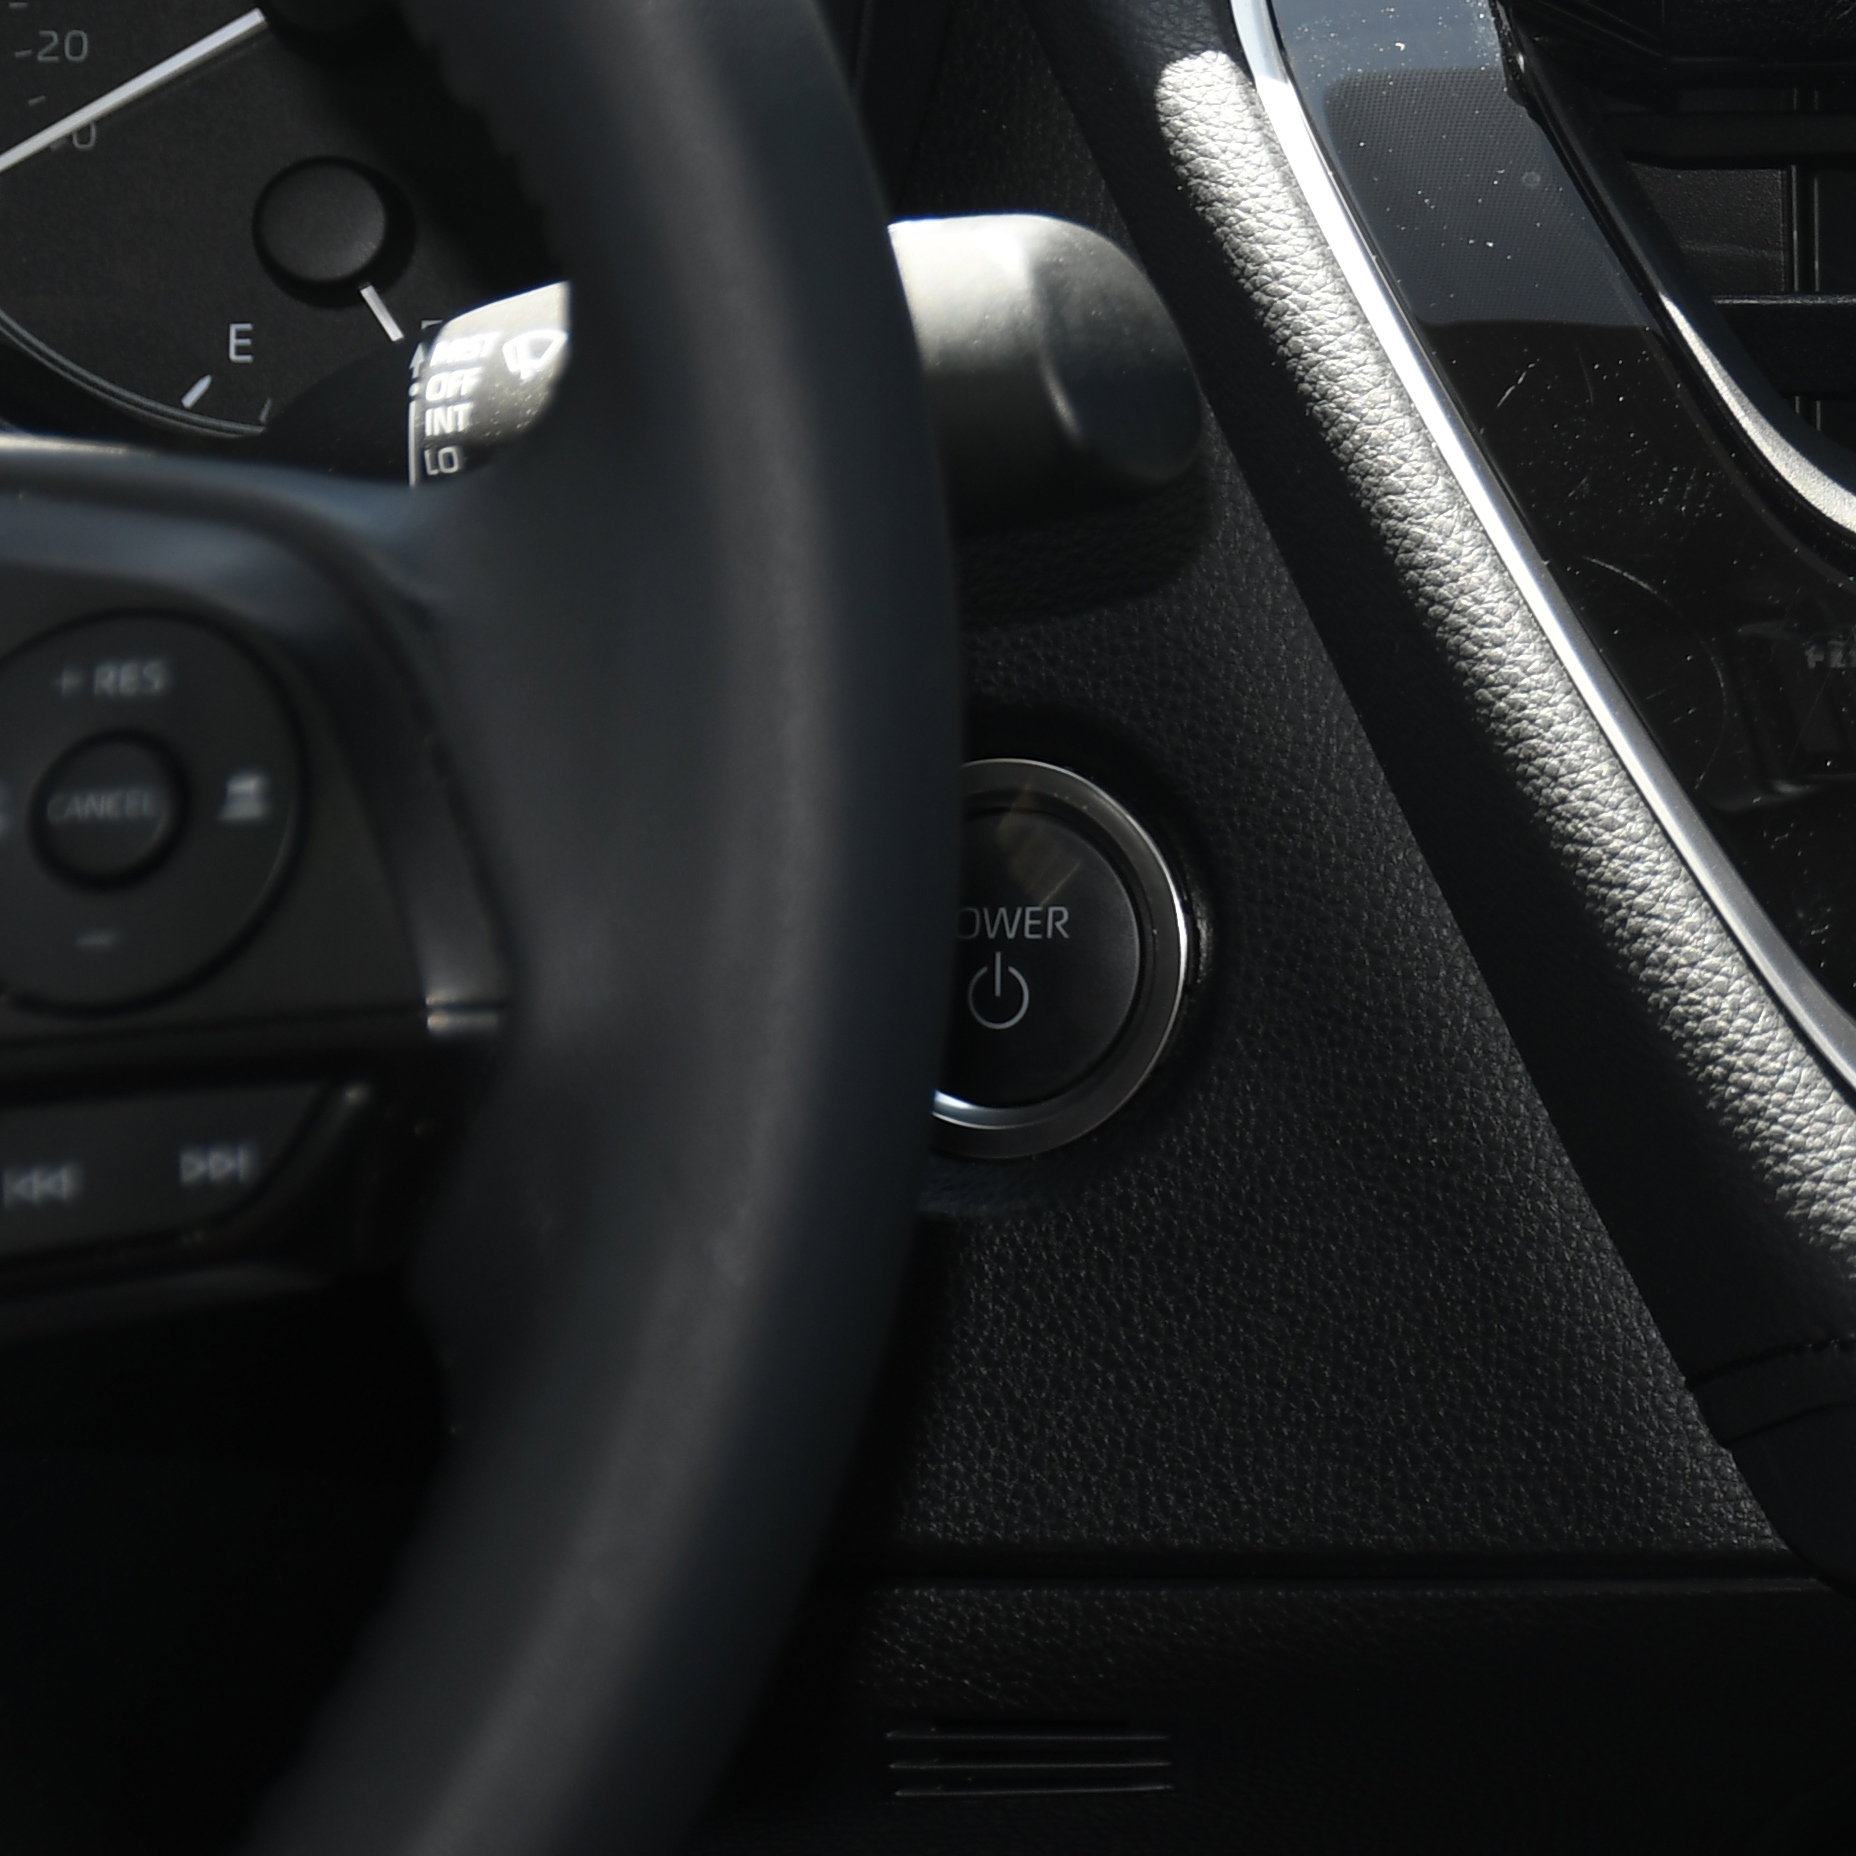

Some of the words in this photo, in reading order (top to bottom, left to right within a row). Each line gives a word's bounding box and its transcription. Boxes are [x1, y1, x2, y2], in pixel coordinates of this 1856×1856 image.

[36, 29, 89, 63] 20
[228, 322, 254, 364] E
[425, 367, 483, 402] OFF
[425, 401, 474, 437] INT
[424, 445, 460, 476] LO
[94, 658, 168, 698] RES
[955, 905, 1070, 941] OWER
